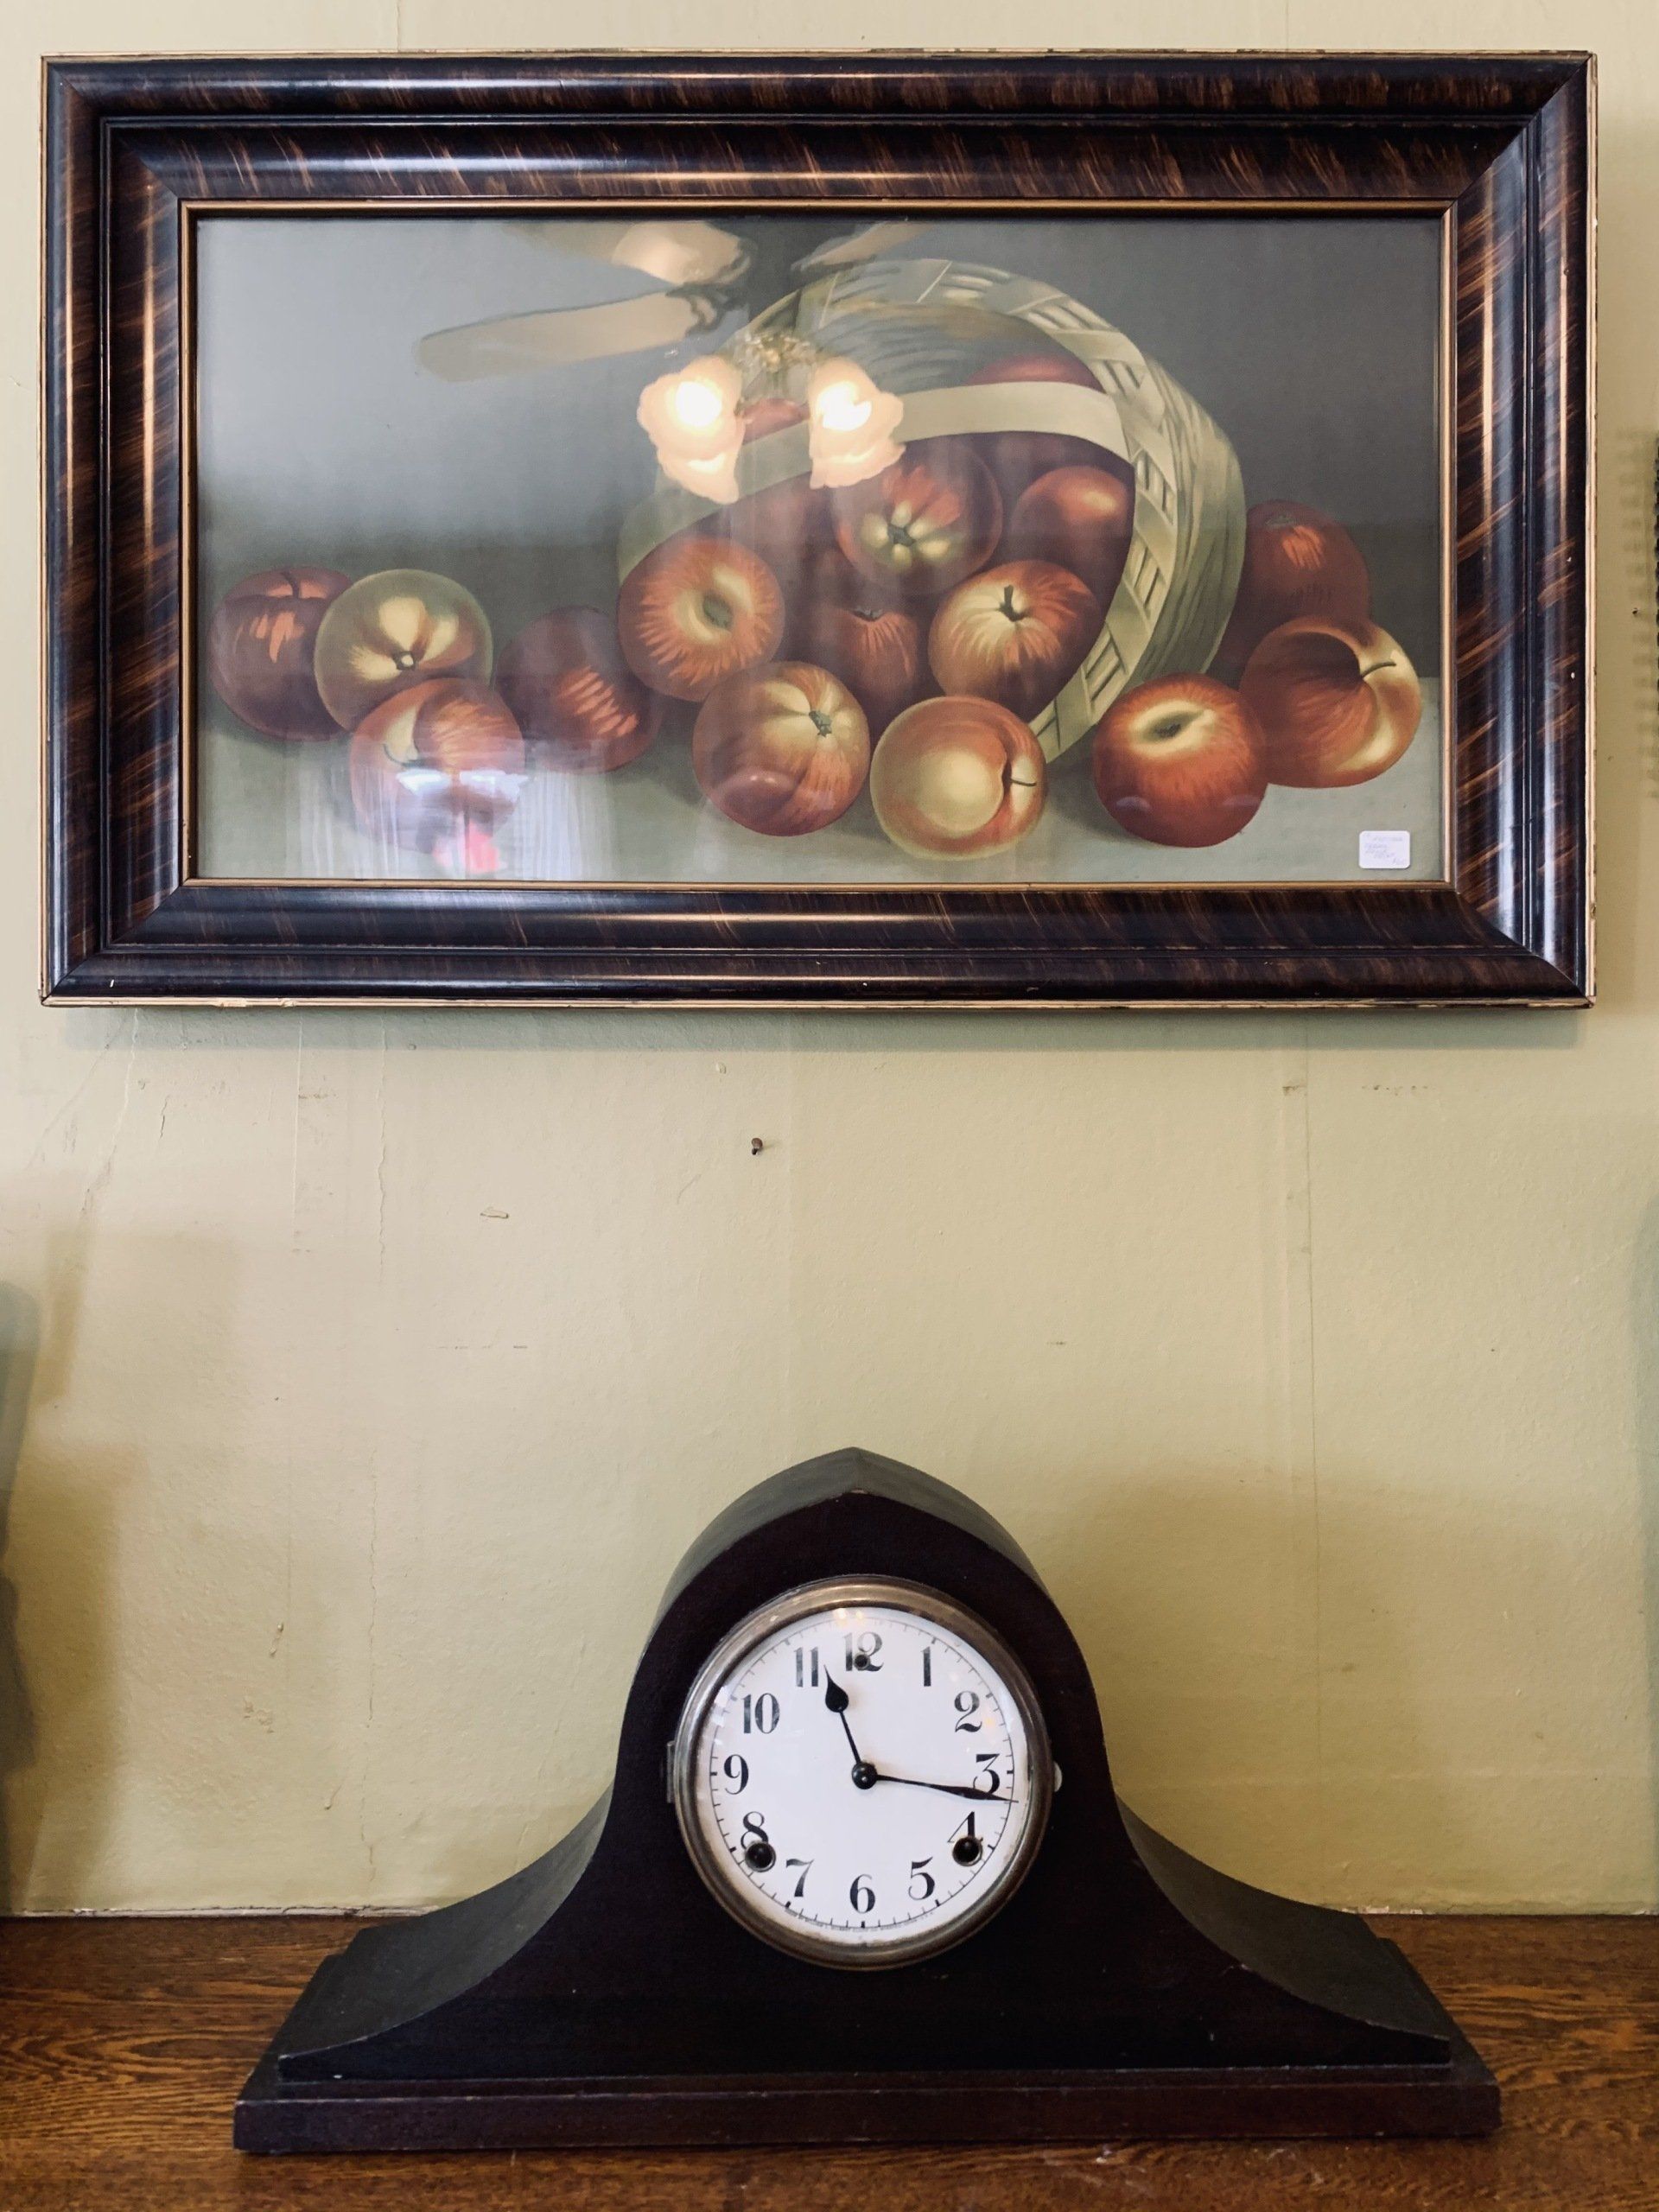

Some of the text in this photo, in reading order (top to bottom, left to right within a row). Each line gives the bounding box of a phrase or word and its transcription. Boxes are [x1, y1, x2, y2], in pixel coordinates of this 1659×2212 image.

[793, 1647, 819, 1687] 11
[844, 1632, 883, 1672] 12
[919, 1646, 931, 1687] 1
[741, 1693, 780, 1733] 10
[954, 1691, 982, 1732] 2
[724, 1754, 749, 1795] 9
[972, 1753, 1001, 1795] 3
[741, 1811, 769, 1851] 8
[786, 1859, 814, 1897] 7
[849, 1874, 876, 1914] 6
[908, 1857, 936, 1901] 5
